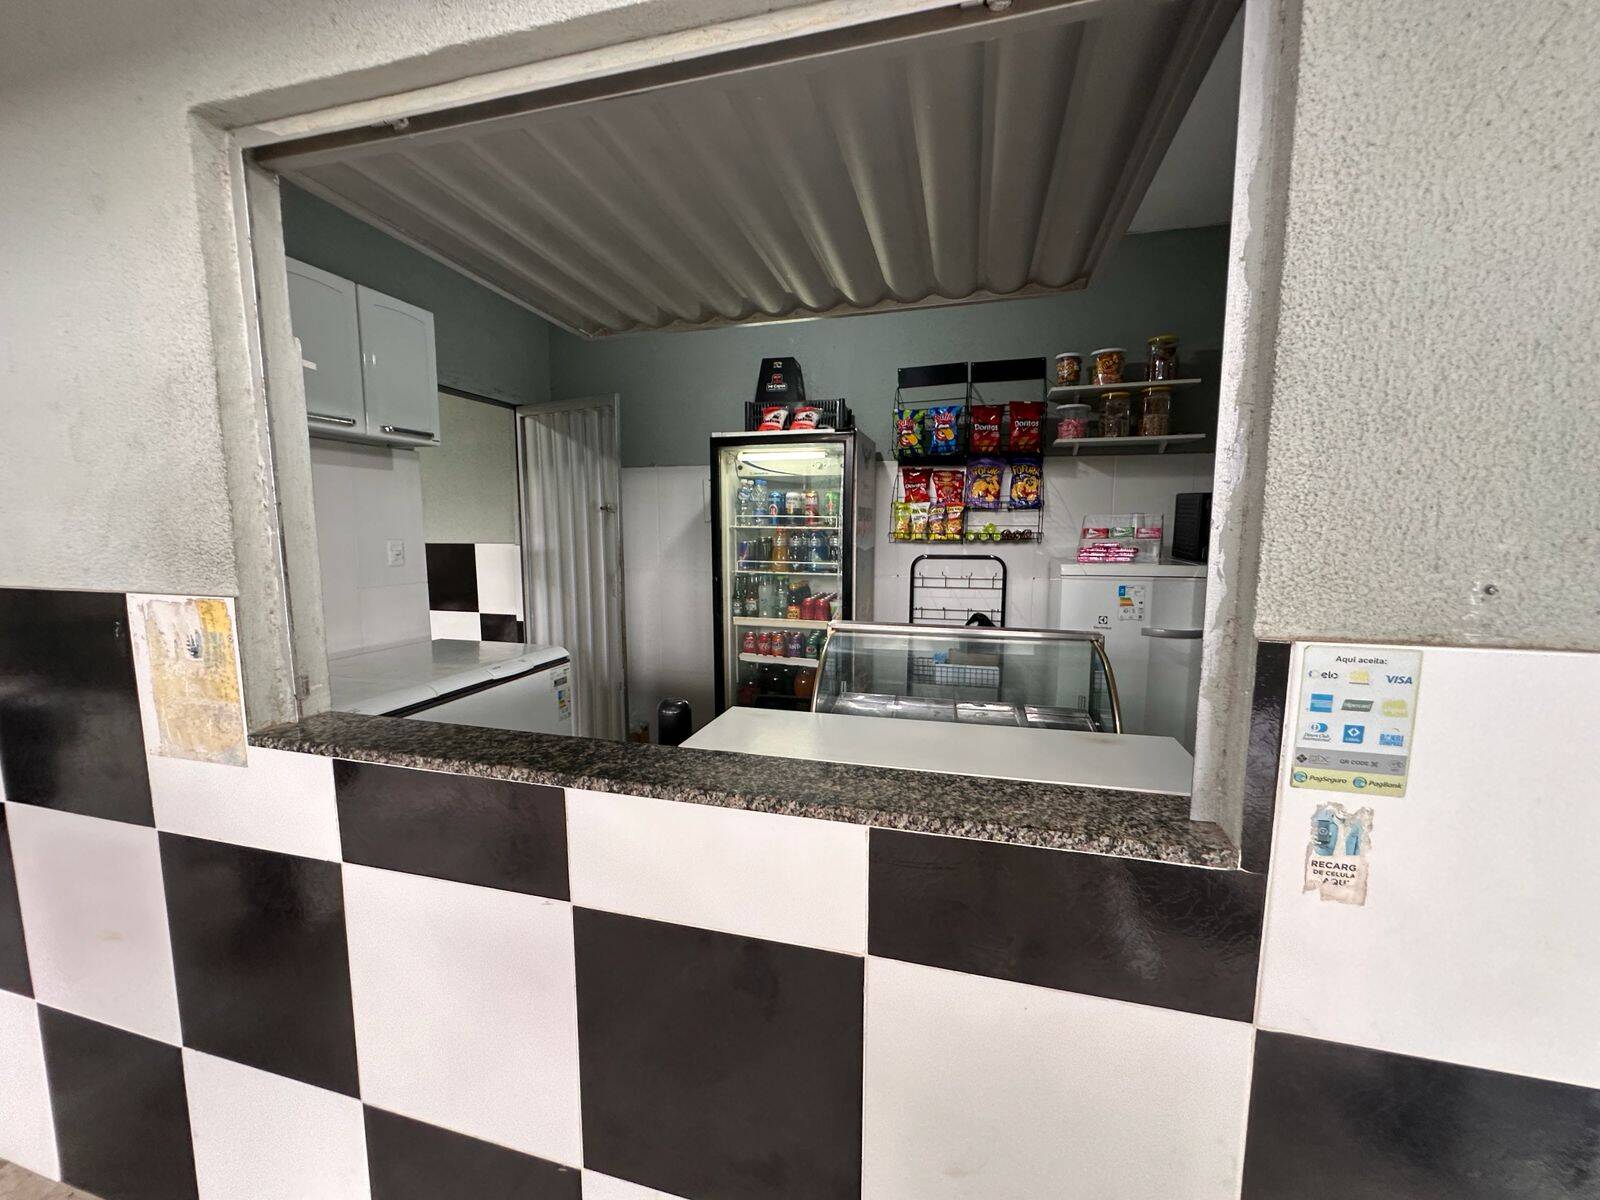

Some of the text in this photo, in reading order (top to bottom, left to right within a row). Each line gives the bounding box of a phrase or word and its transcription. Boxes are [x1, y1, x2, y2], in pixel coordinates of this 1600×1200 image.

[974, 423, 998, 432] Doritos
[1014, 419, 1039, 427] Doritos
[1335, 655, 1388, 665] Aqui aceita:
[1386, 674, 1413, 685] VISA
[1309, 774, 1348, 784] PagSeguro
[1368, 780, 1402, 789] PagBank
[1325, 870, 1355, 879] CELULA
